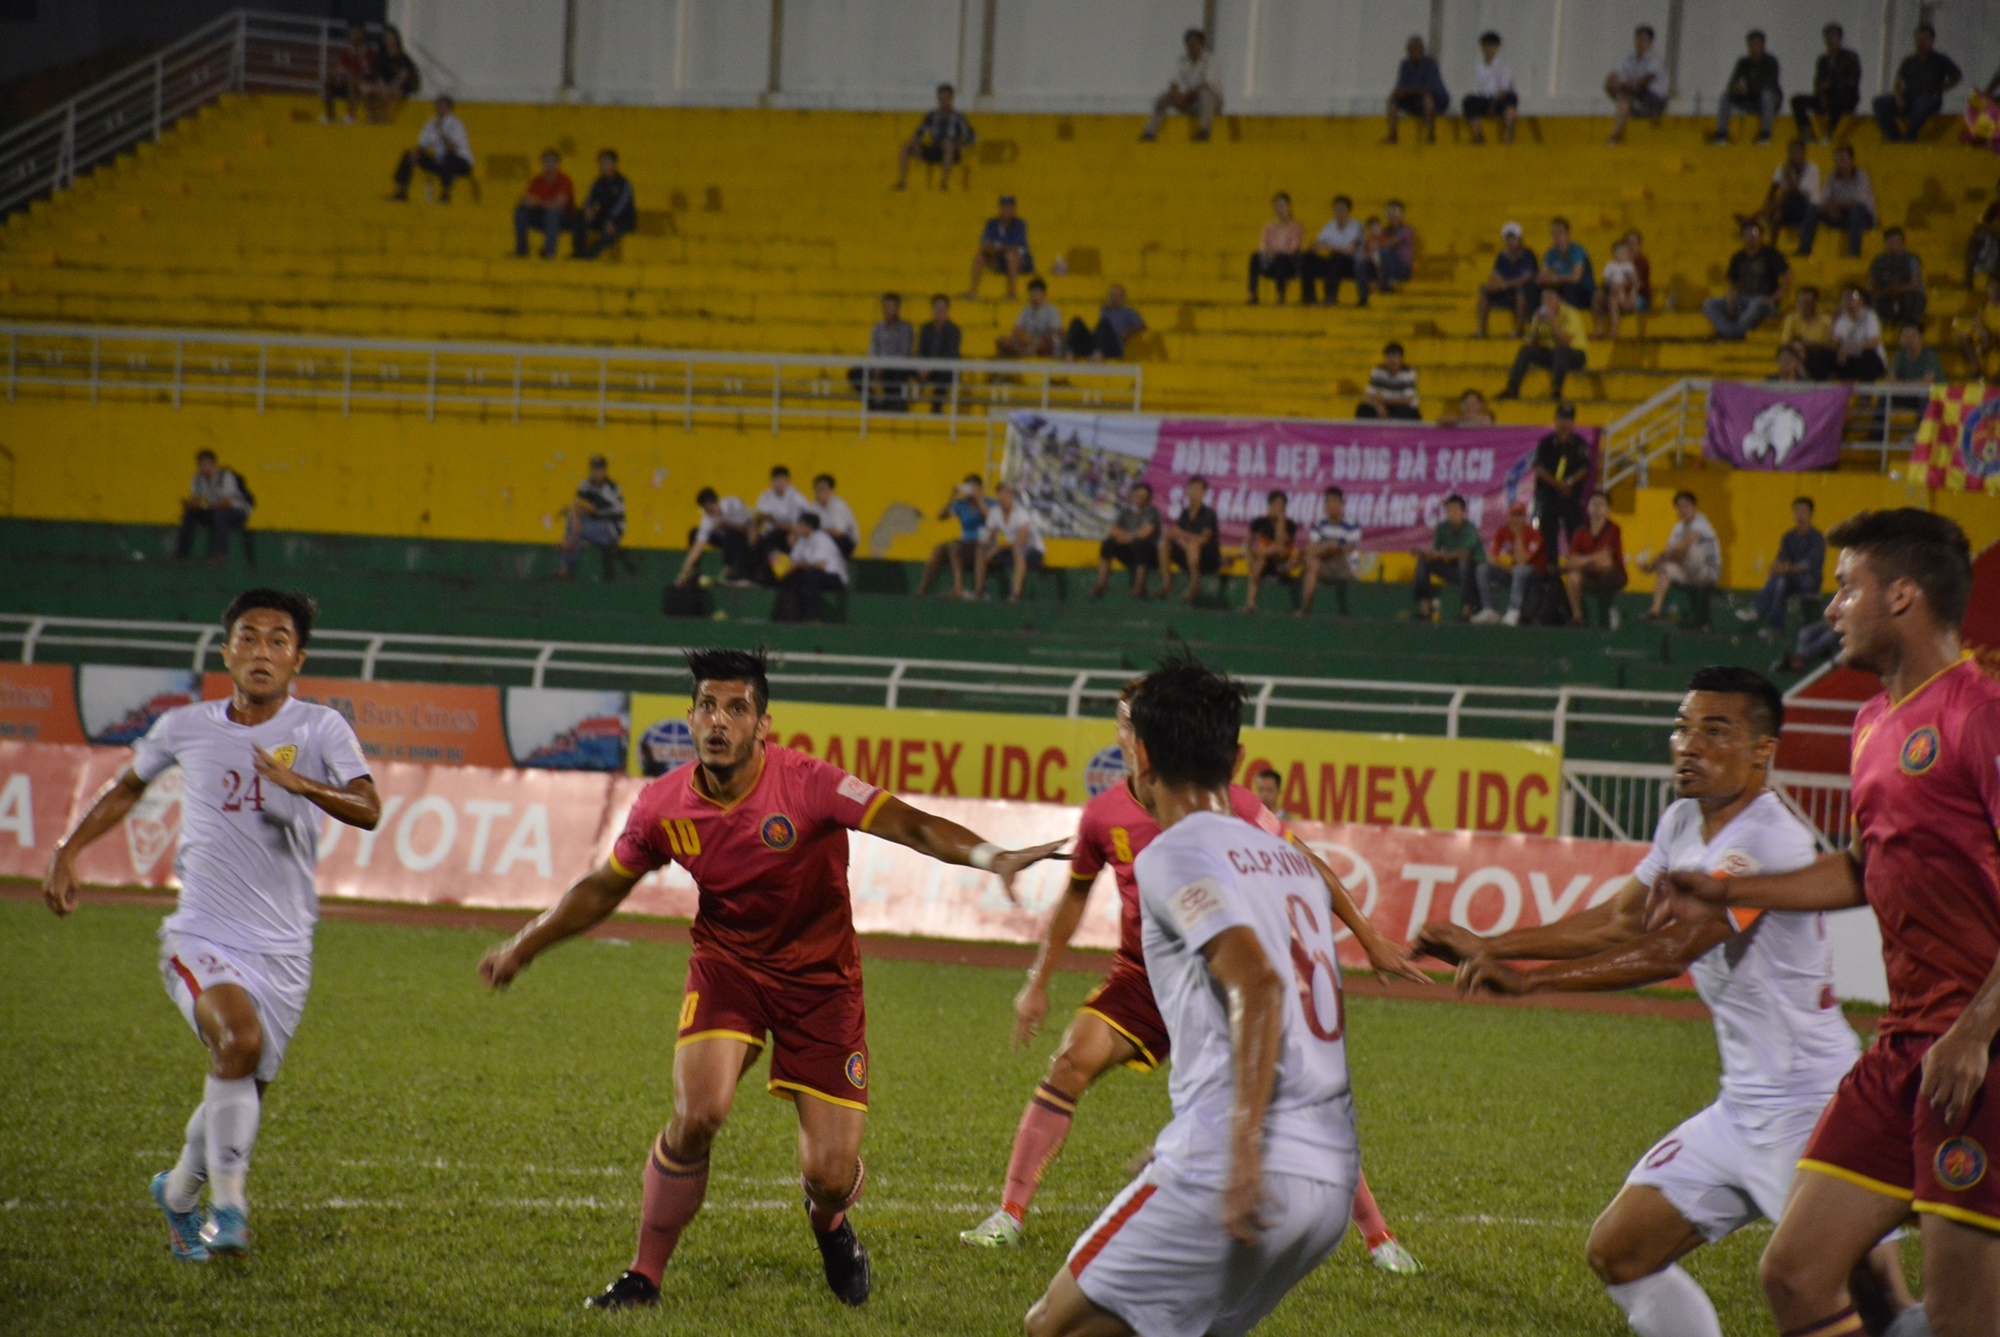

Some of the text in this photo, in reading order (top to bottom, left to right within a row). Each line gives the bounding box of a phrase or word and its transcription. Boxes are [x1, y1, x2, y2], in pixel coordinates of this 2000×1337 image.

[222, 769, 265, 813] 24
[981, 744, 1068, 804] IDC
[1242, 758, 1550, 835] AMEX IDC
[318, 795, 553, 878] YOTA
[661, 818, 702, 855] 10
[1110, 826, 1134, 863] 8
[1401, 863, 1633, 943] TOY
[1286, 893, 1345, 1042] 6
